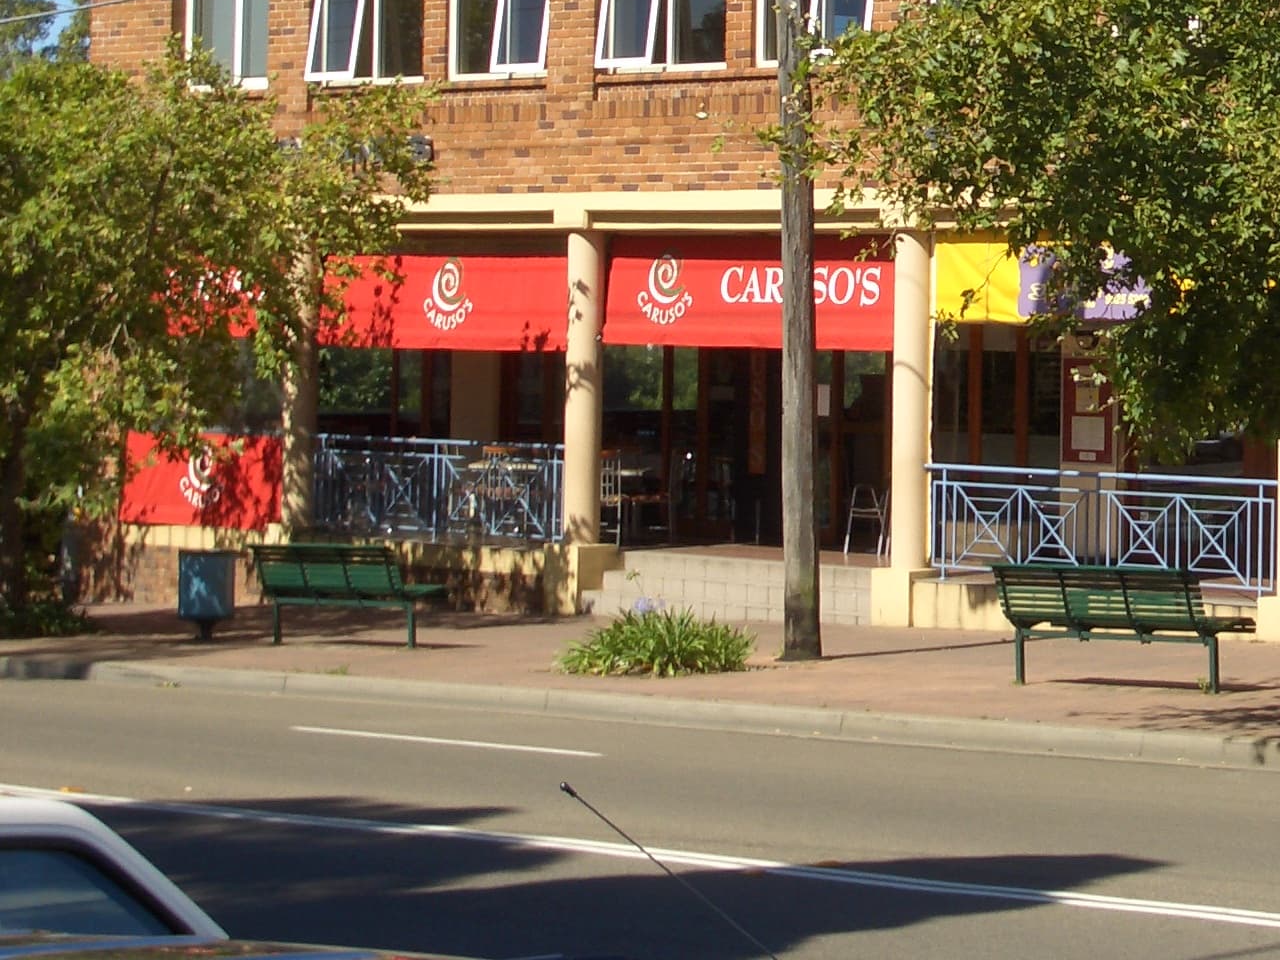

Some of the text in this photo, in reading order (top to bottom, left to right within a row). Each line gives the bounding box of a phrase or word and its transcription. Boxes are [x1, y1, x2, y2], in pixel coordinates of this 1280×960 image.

[637, 266, 881, 325] CARUSO'S CARSO'S
[423, 297, 474, 331] CARUSO'S
[179, 476, 226, 509] CARUSO
